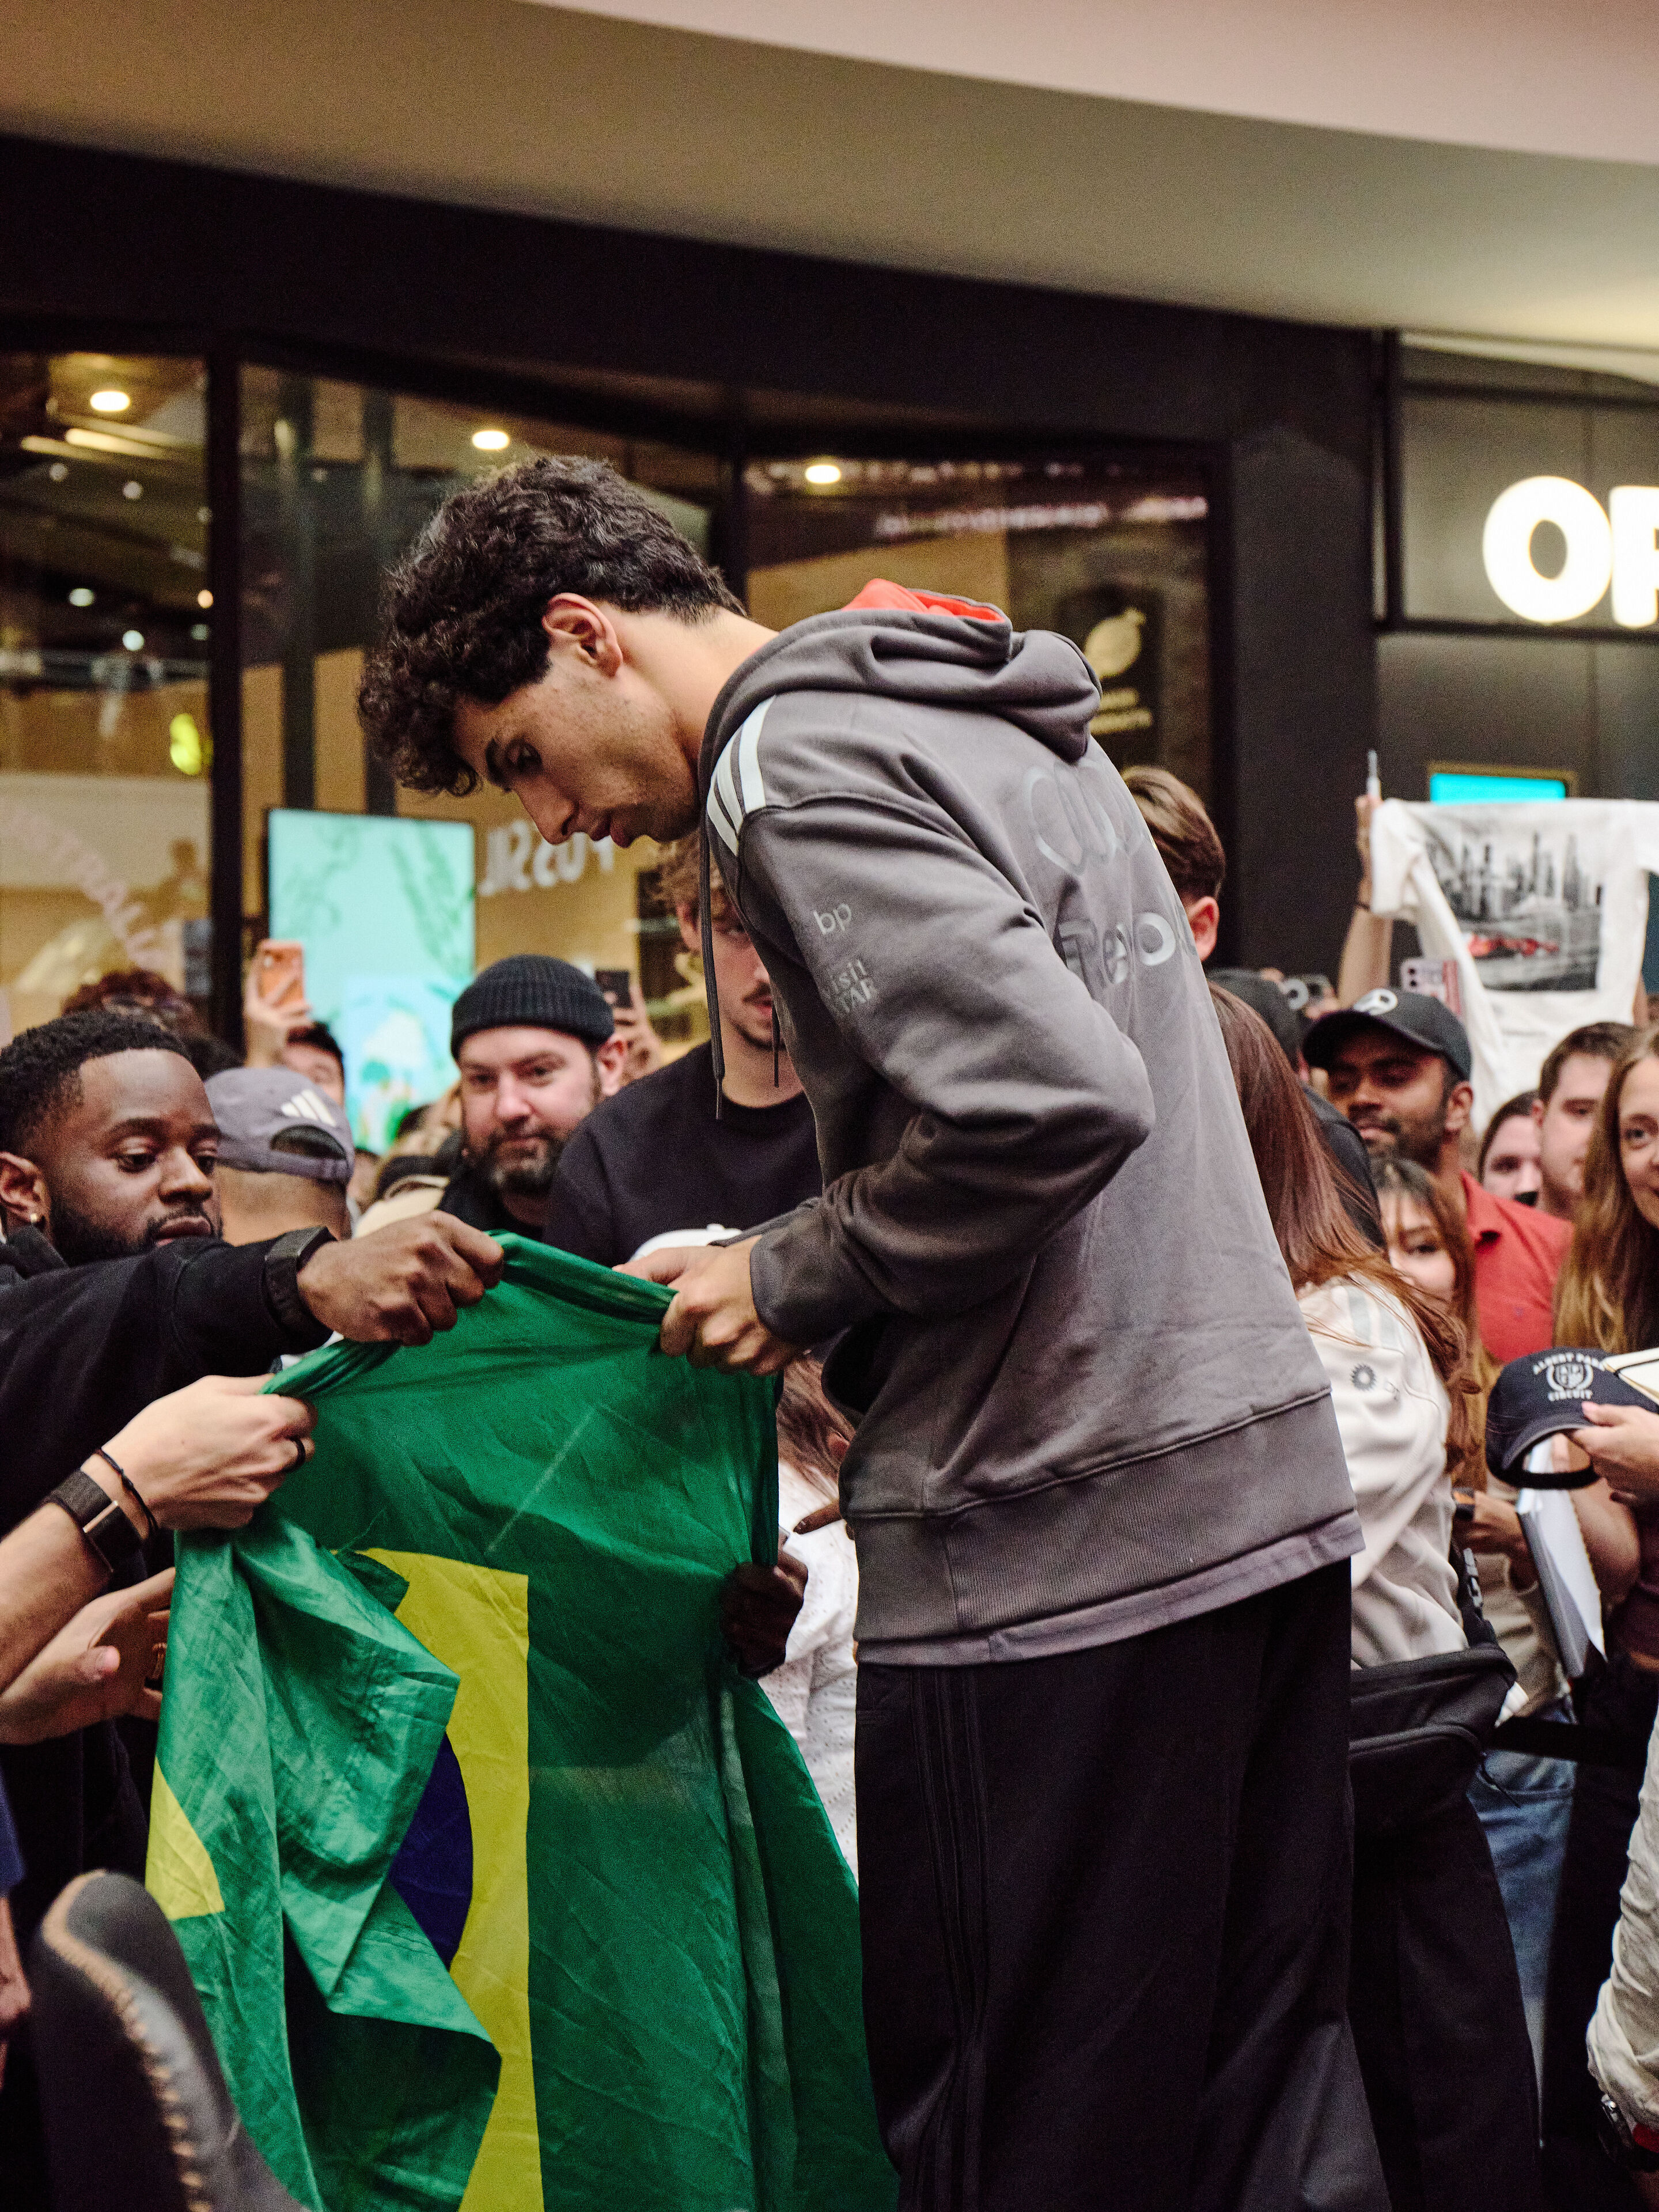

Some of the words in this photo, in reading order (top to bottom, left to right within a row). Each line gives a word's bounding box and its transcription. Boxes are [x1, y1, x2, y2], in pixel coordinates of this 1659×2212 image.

[813, 903, 851, 935] bp
[1533, 1353, 1574, 1375] ALBERT
[1548, 1389, 1593, 1402] CIRCUIT
